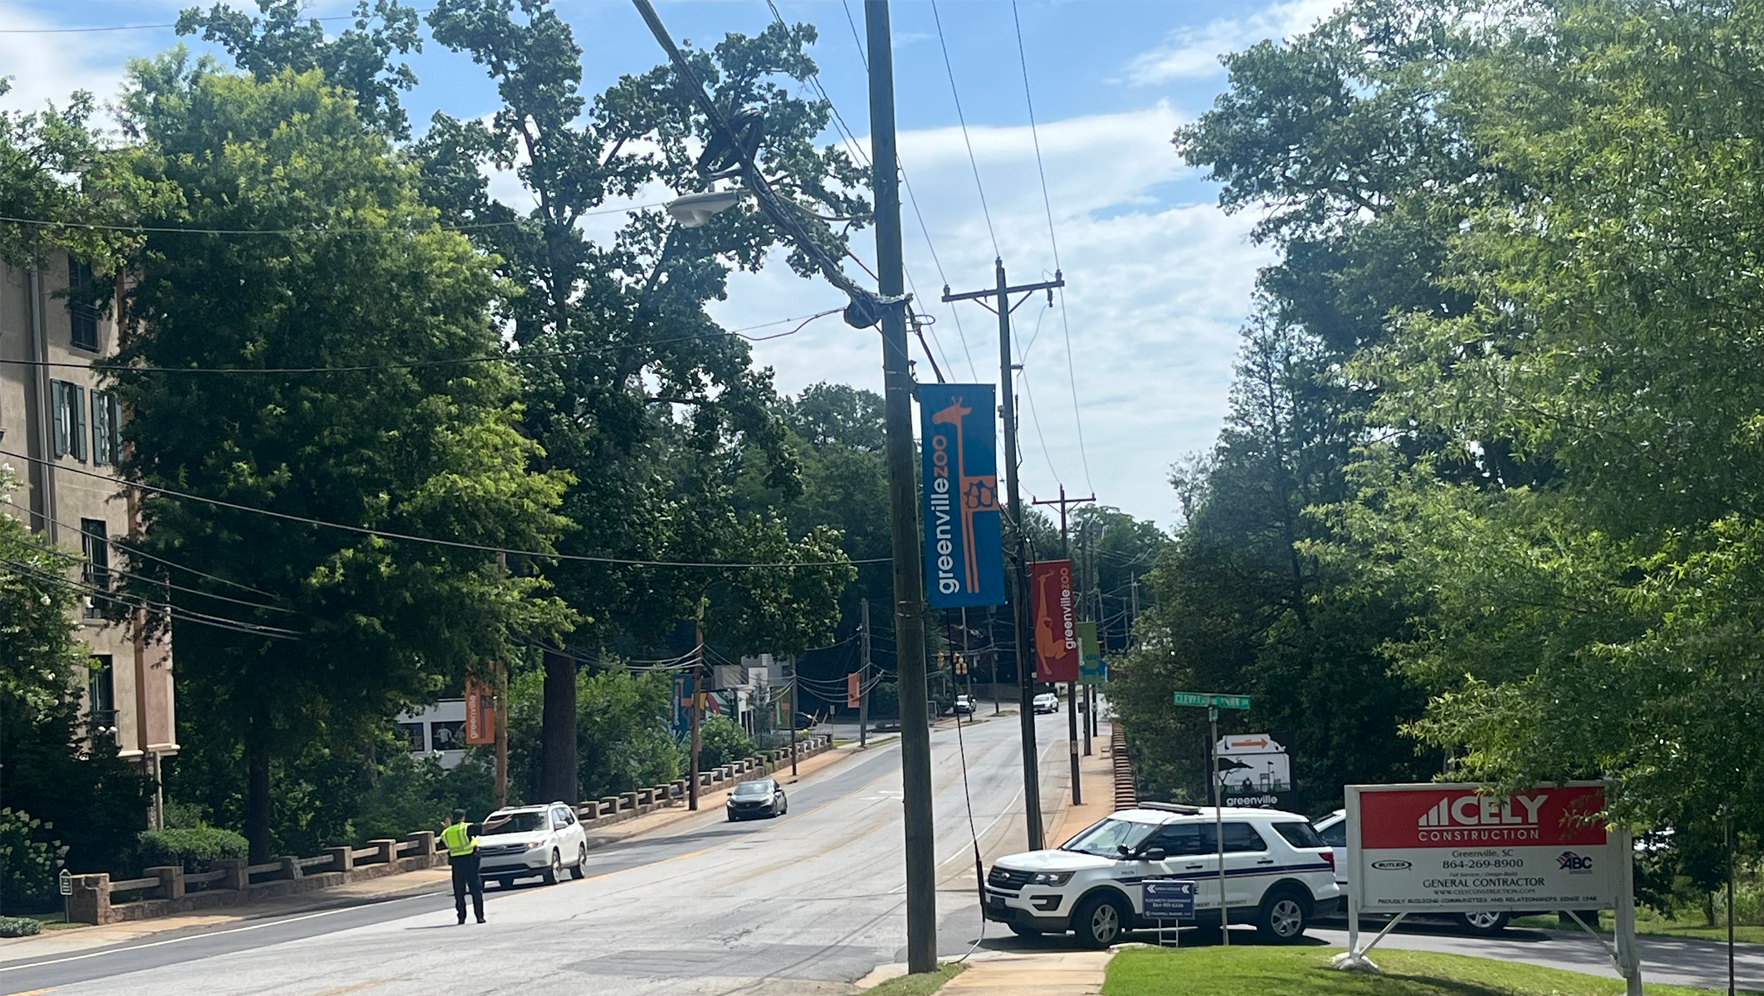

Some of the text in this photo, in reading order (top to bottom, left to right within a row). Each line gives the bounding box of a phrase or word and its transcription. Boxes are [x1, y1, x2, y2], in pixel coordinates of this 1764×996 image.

[931, 434, 960, 595] greenvillezoo
[1060, 567, 1077, 650] greenvillezoo
[1175, 694, 1217, 705] CLEVELD
[1226, 794, 1278, 807] greenville
[1451, 795, 1549, 825] CELY
[1418, 829, 1539, 841] CONSTRUCTION
[1451, 849, 1514, 858] Greenville, SC
[1442, 859, 1524, 869] 864-269-8900
[1559, 856, 1593, 870] ABC
[1422, 877, 1546, 888] GENERAL CONTRACTOR
